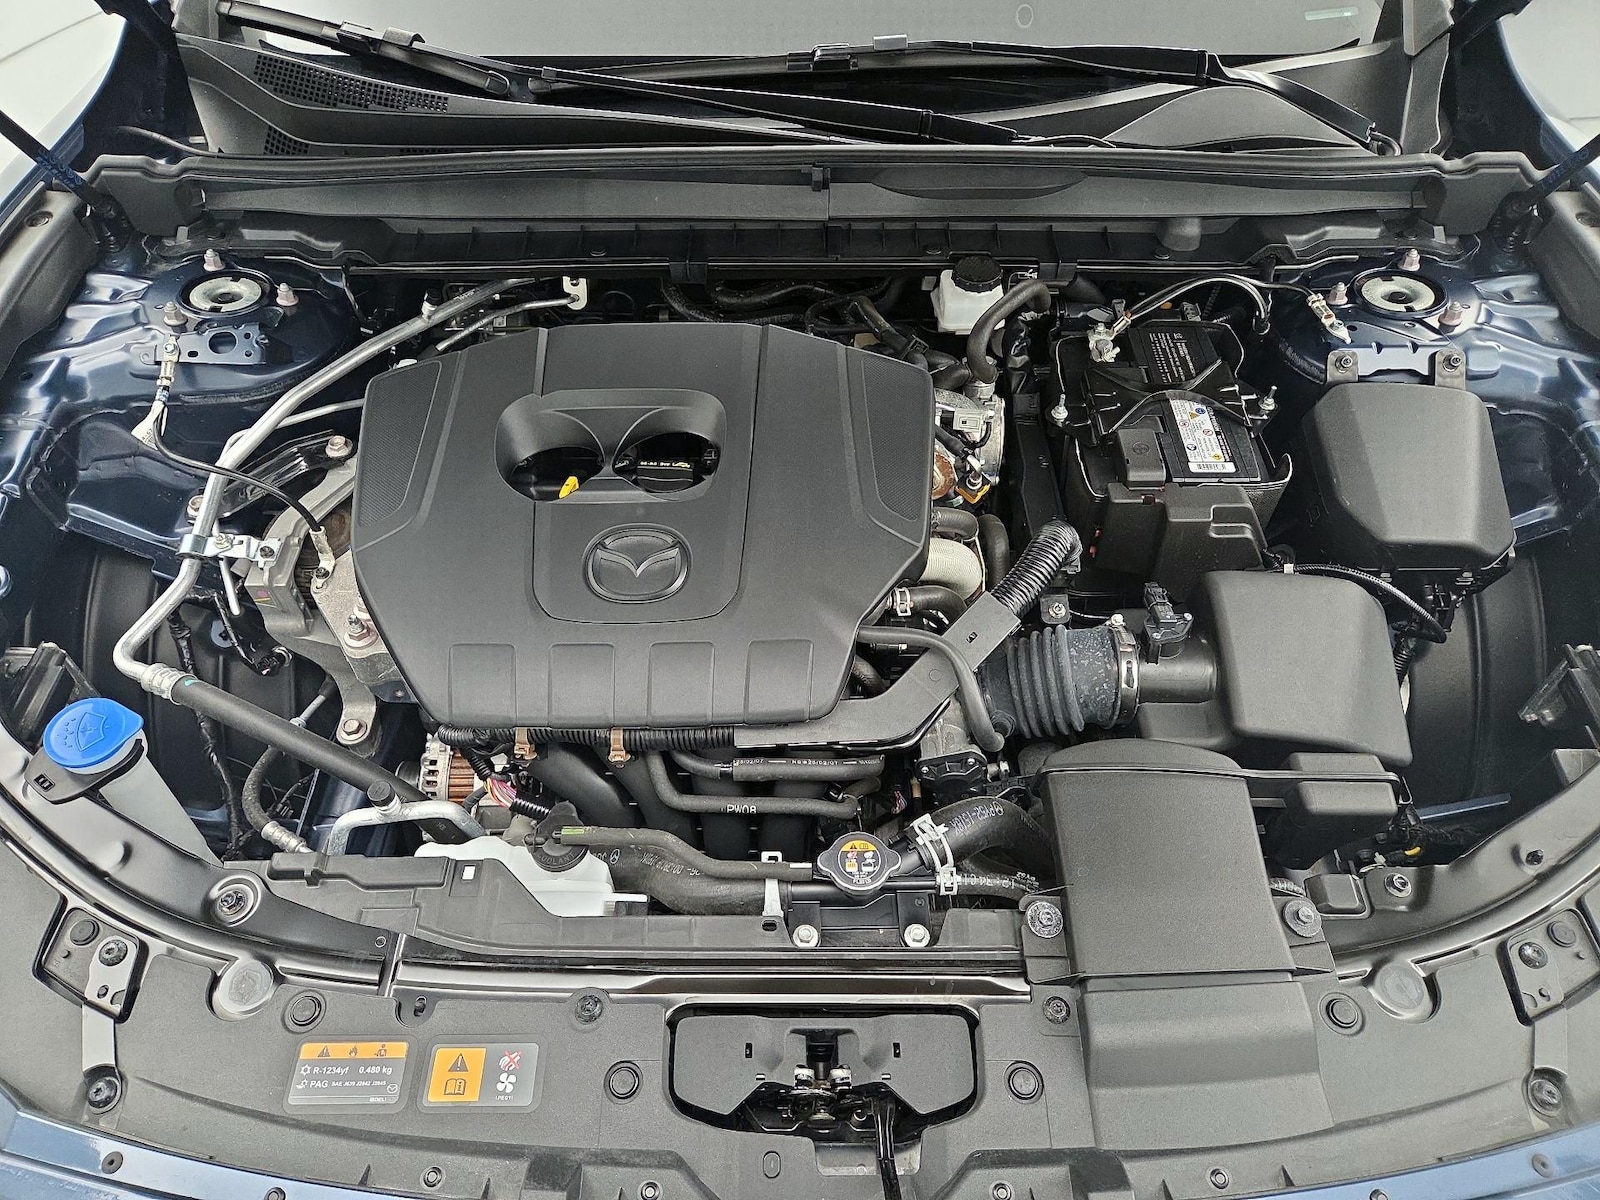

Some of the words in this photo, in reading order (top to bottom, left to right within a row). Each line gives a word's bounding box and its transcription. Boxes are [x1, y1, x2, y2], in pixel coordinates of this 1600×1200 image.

[537, 852, 575, 865] COOLANT
[312, 1066, 350, 1076] R-1234yf
[358, 1065, 381, 1074] 0.480
[382, 1066, 393, 1075] kg
[309, 1080, 328, 1088] PAG
